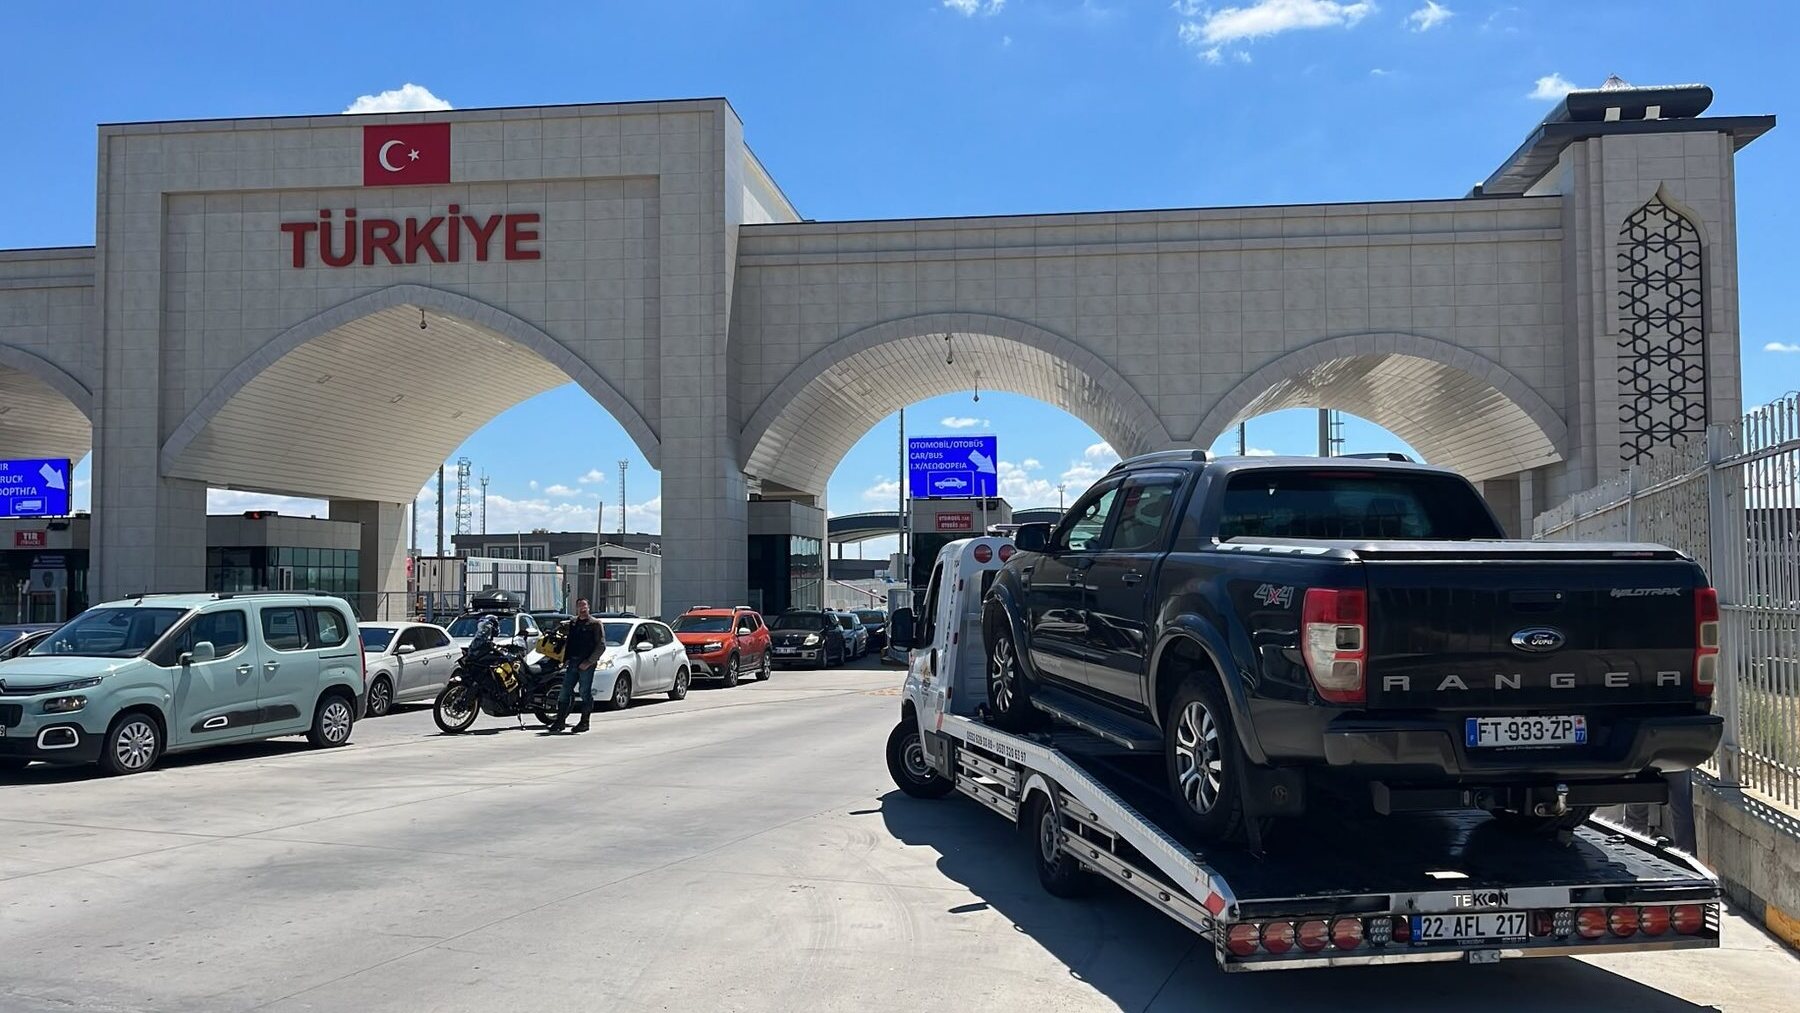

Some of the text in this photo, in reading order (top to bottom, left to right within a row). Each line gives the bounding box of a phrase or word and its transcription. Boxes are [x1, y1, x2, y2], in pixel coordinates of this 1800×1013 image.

[281, 203, 541, 268] TÜRKİYE
[910, 439, 984, 449] OTOMOBİL/OTOBÜS
[910, 452, 944, 460] CAR/BUS
[0, 463, 9, 471] IR
[0, 475, 24, 484] RUCK
[23, 532, 38, 540] TIR
[1610, 587, 1681, 598] WILDTRAK
[1531, 634, 1555, 645] Ford
[1382, 671, 1681, 692] RANGER
[1478, 720, 1573, 742] FT-933-ZP
[1575, 730, 1585, 741] 77
[1423, 917, 1443, 937] 22
[1454, 915, 1485, 937] AFL
[1496, 914, 1525, 935] 217
